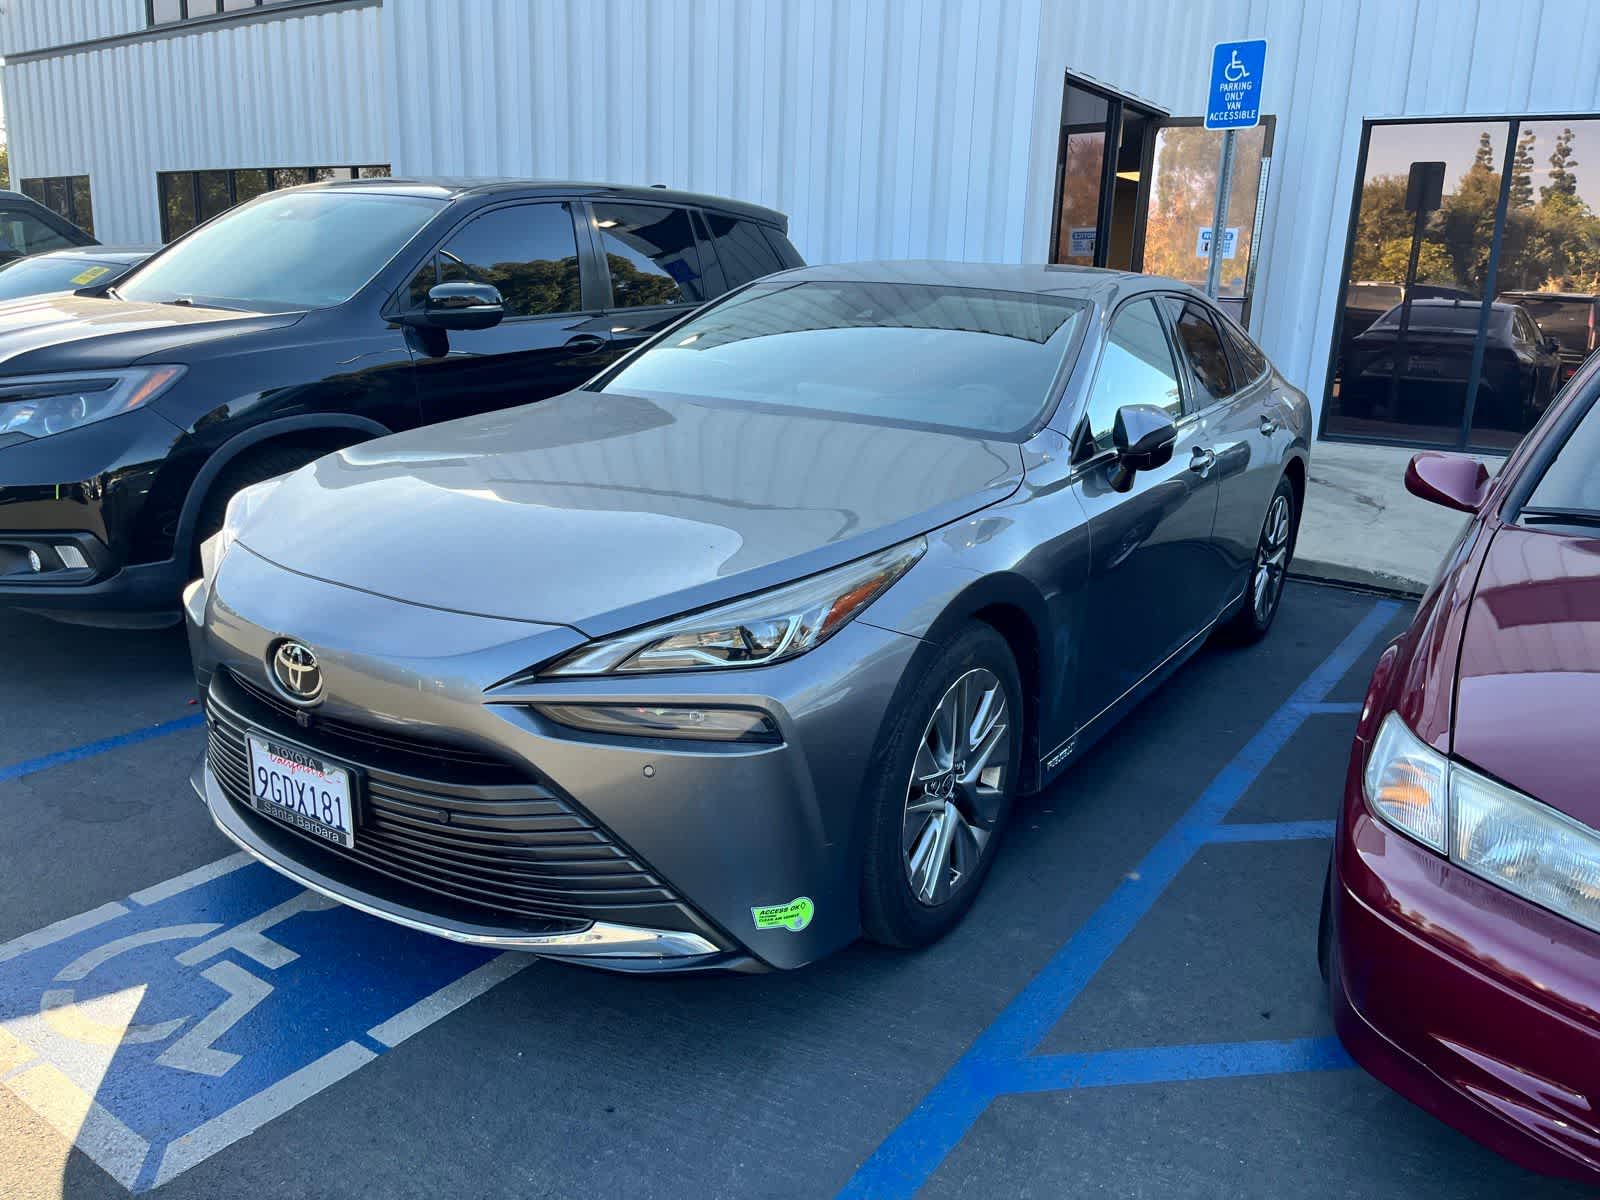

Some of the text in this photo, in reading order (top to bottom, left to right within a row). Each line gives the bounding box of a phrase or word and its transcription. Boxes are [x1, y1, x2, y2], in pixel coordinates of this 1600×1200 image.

[1219, 81, 1252, 92] PARKING
[1224, 92, 1244, 101] ONLY
[1227, 102, 1241, 110] VAN
[1209, 110, 1256, 120] ACCESSIBLE
[274, 745, 316, 768] TOYOTA
[257, 766, 347, 832] 9GDX181
[263, 800, 340, 842] Santa Barbara
[760, 907, 789, 915] ACCESS
